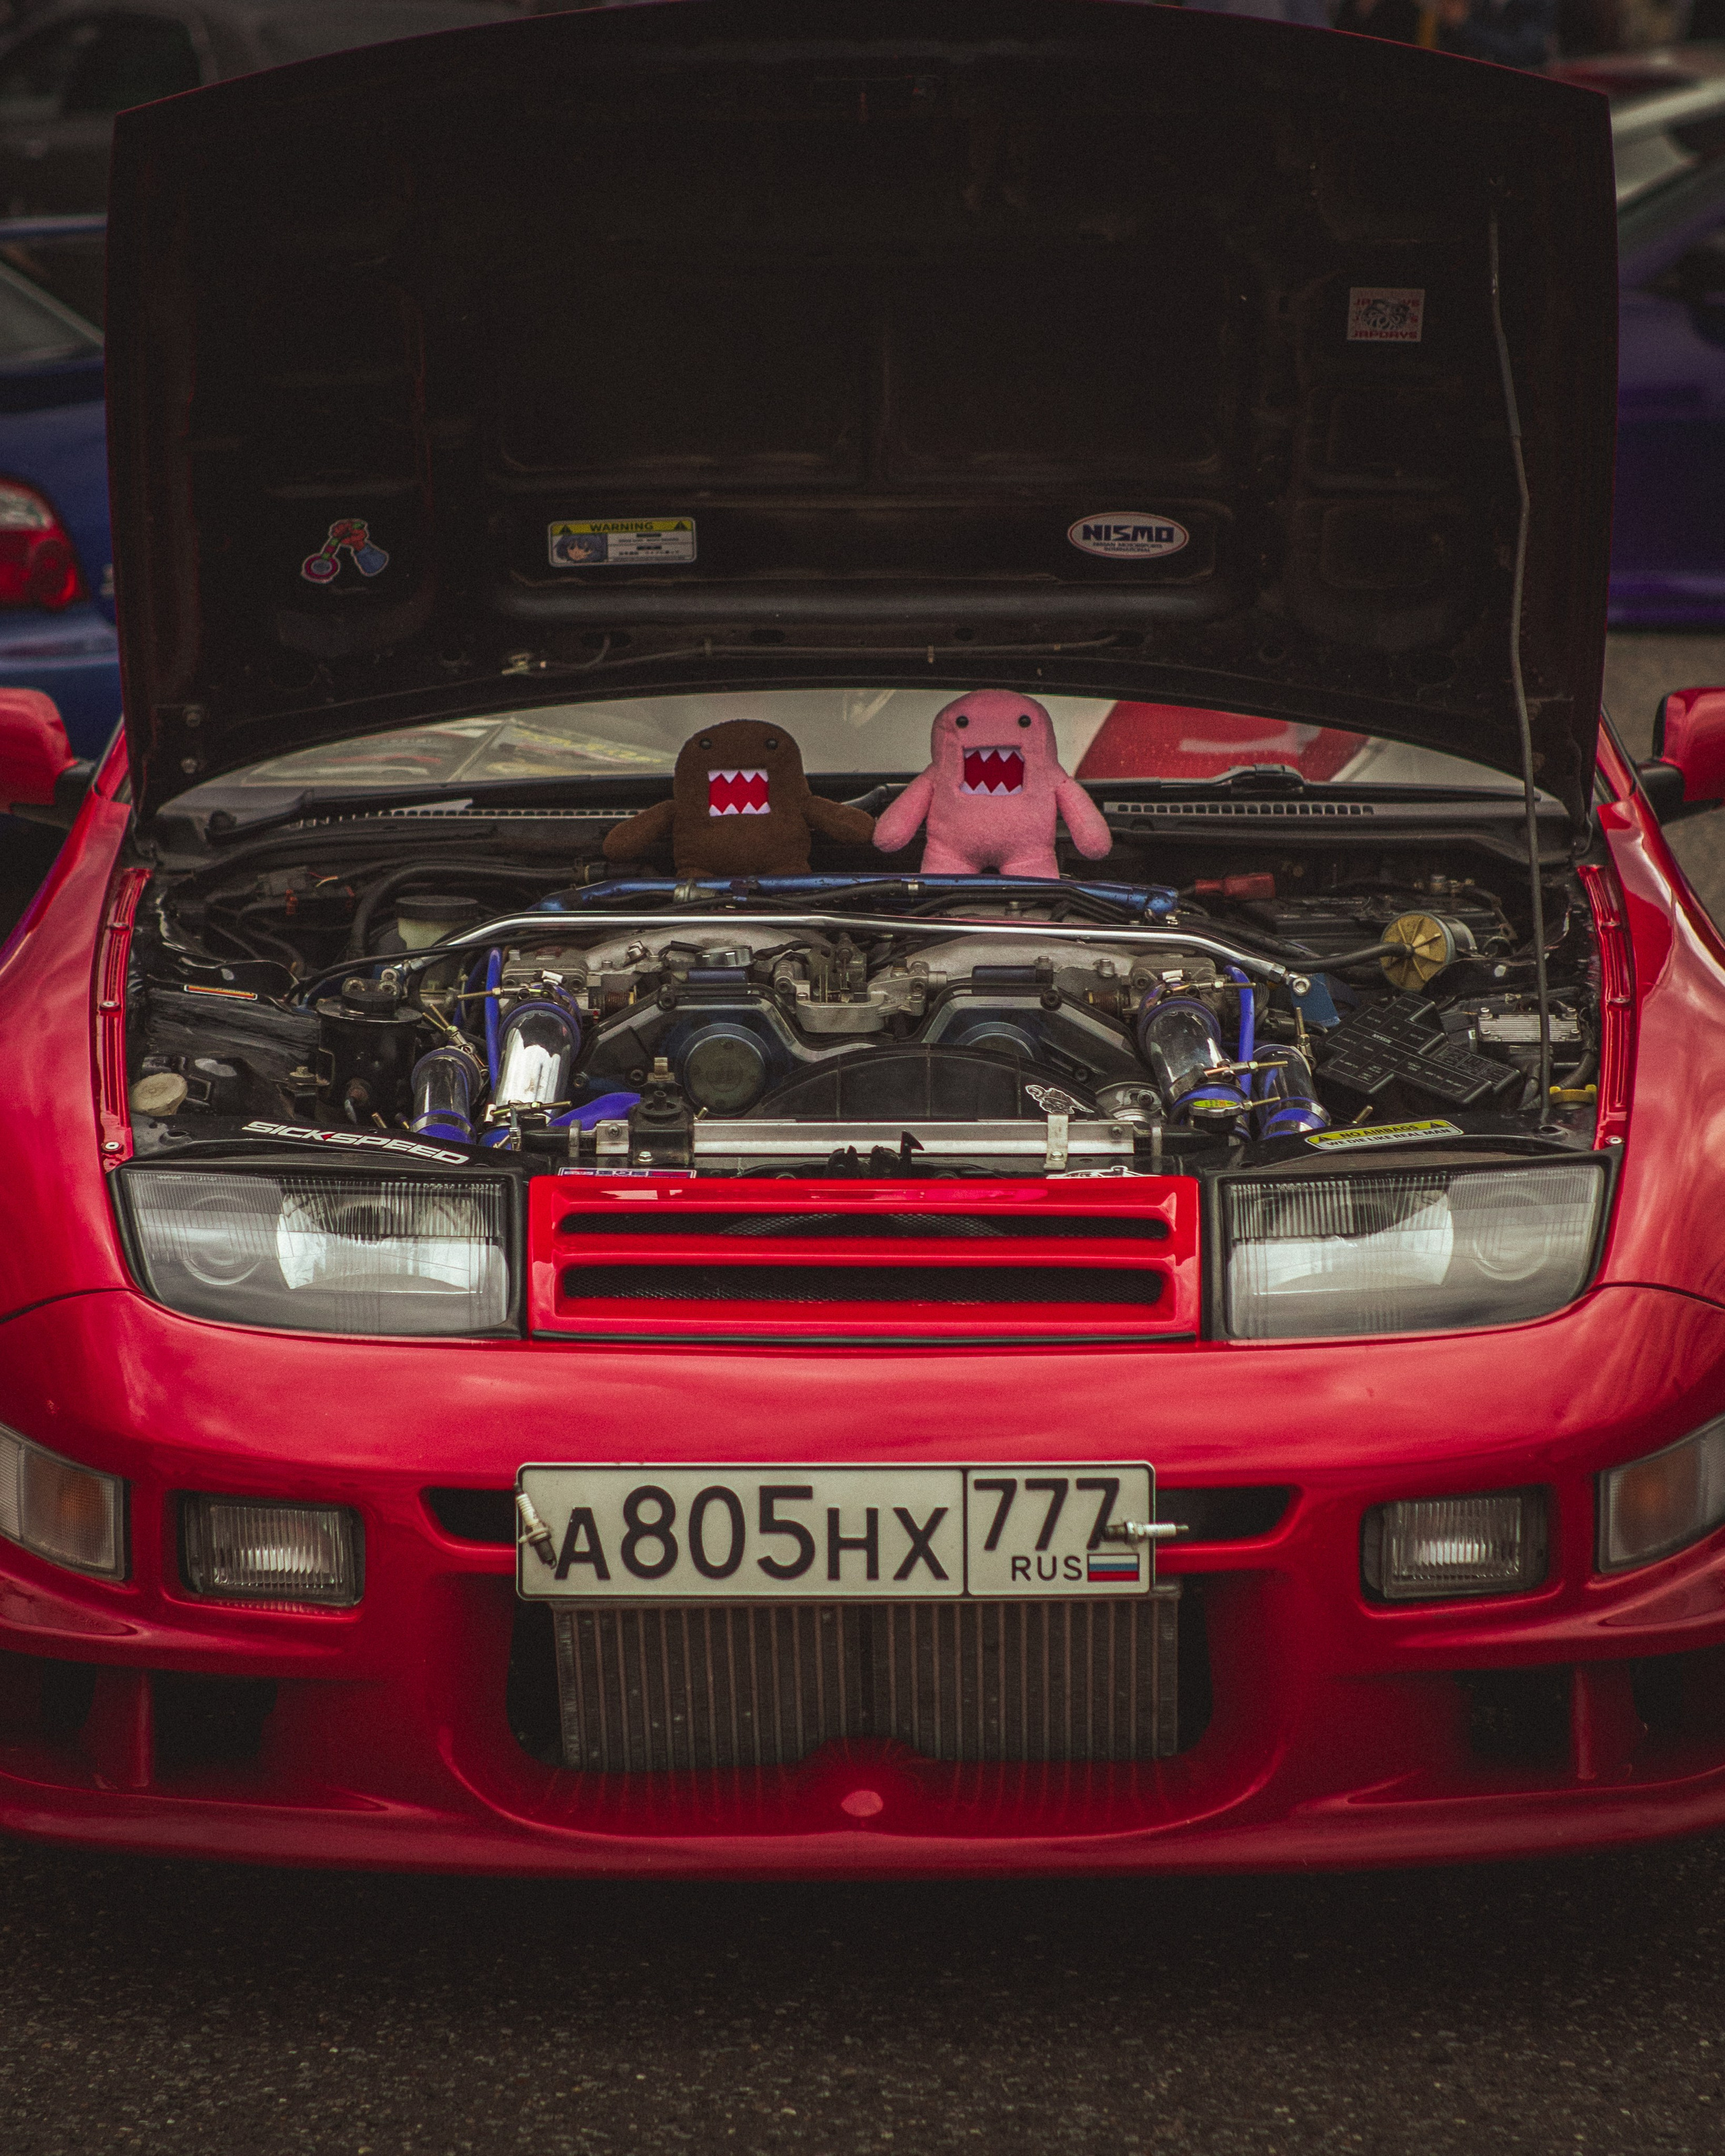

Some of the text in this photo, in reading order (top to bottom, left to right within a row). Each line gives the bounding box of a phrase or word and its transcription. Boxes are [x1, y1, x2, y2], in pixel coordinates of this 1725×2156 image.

[590, 521, 654, 532] WARNING
[1082, 524, 1174, 542] NISMO
[1339, 1124, 1420, 1139] NO AIRBAGS
[1393, 1131, 1418, 1140] REAL
[241, 1120, 470, 1165] SICKSPEED
[555, 1478, 1121, 1581] A805HX 777
[1011, 1555, 1083, 1581] RUS
